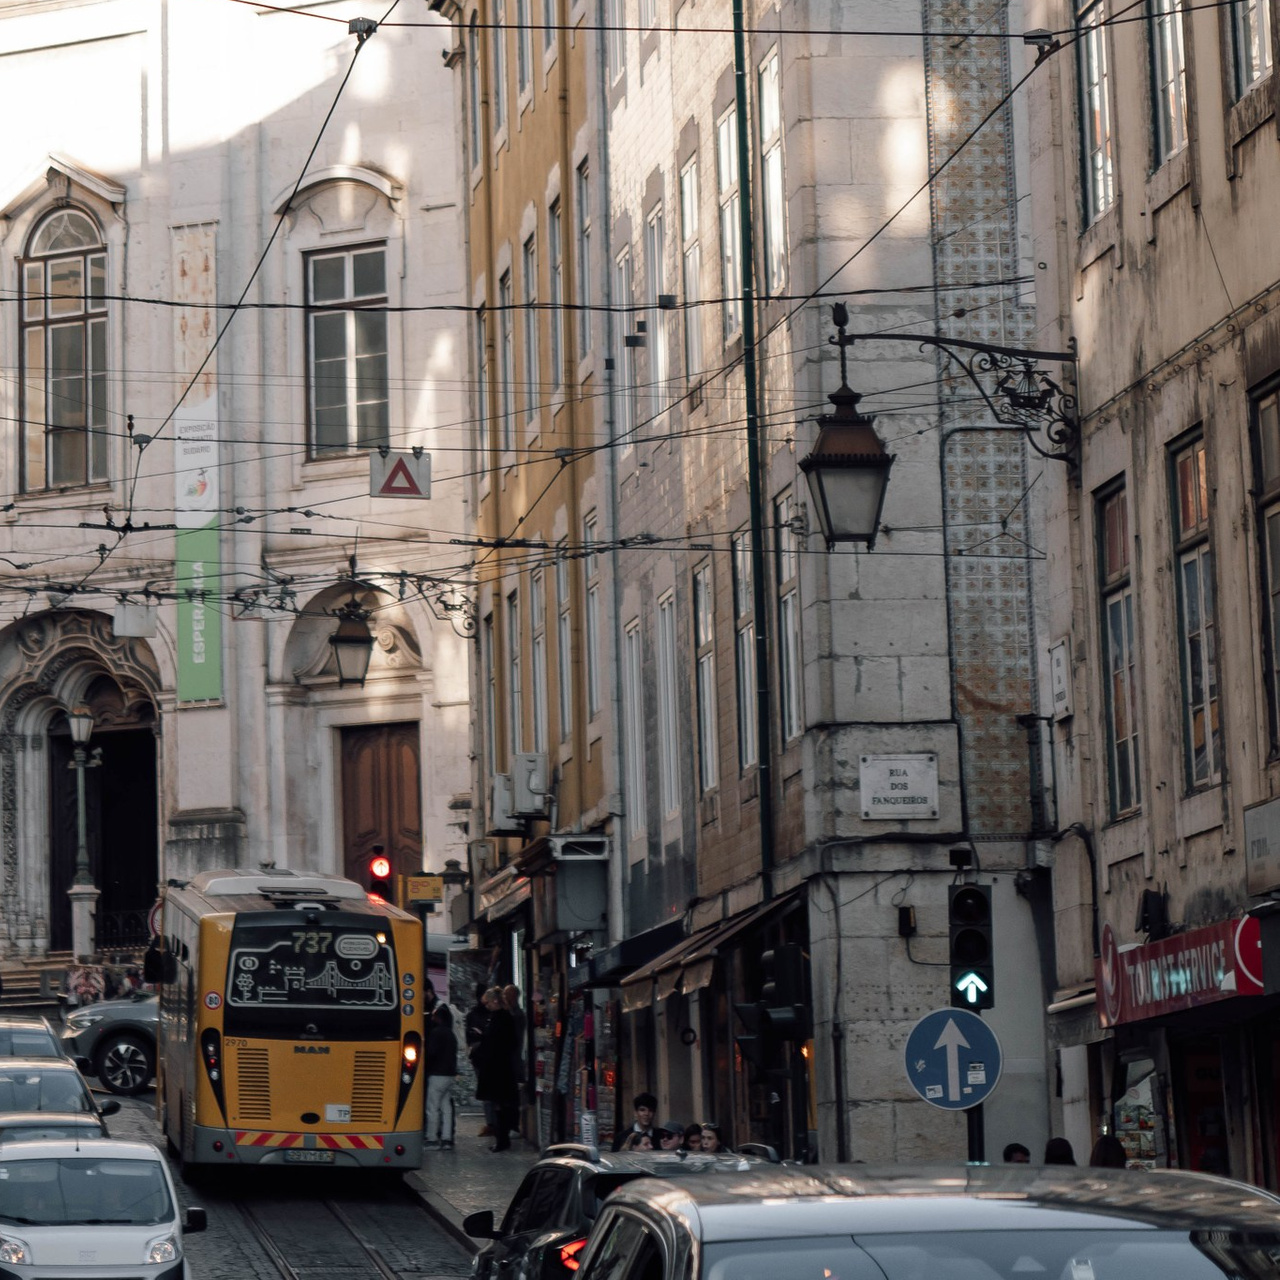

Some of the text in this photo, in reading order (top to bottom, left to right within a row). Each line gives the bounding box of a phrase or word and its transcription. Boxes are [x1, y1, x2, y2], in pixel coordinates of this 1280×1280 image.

[889, 769, 908, 777] RUA
[890, 782, 908, 790] DOS
[872, 797, 928, 805] FANQUEIROS
[292, 931, 333, 954] 737
[1127, 940, 1226, 1008] TOURIST SERVICE
[225, 1038, 248, 1047] 2970
[294, 1045, 330, 1055] MAN
